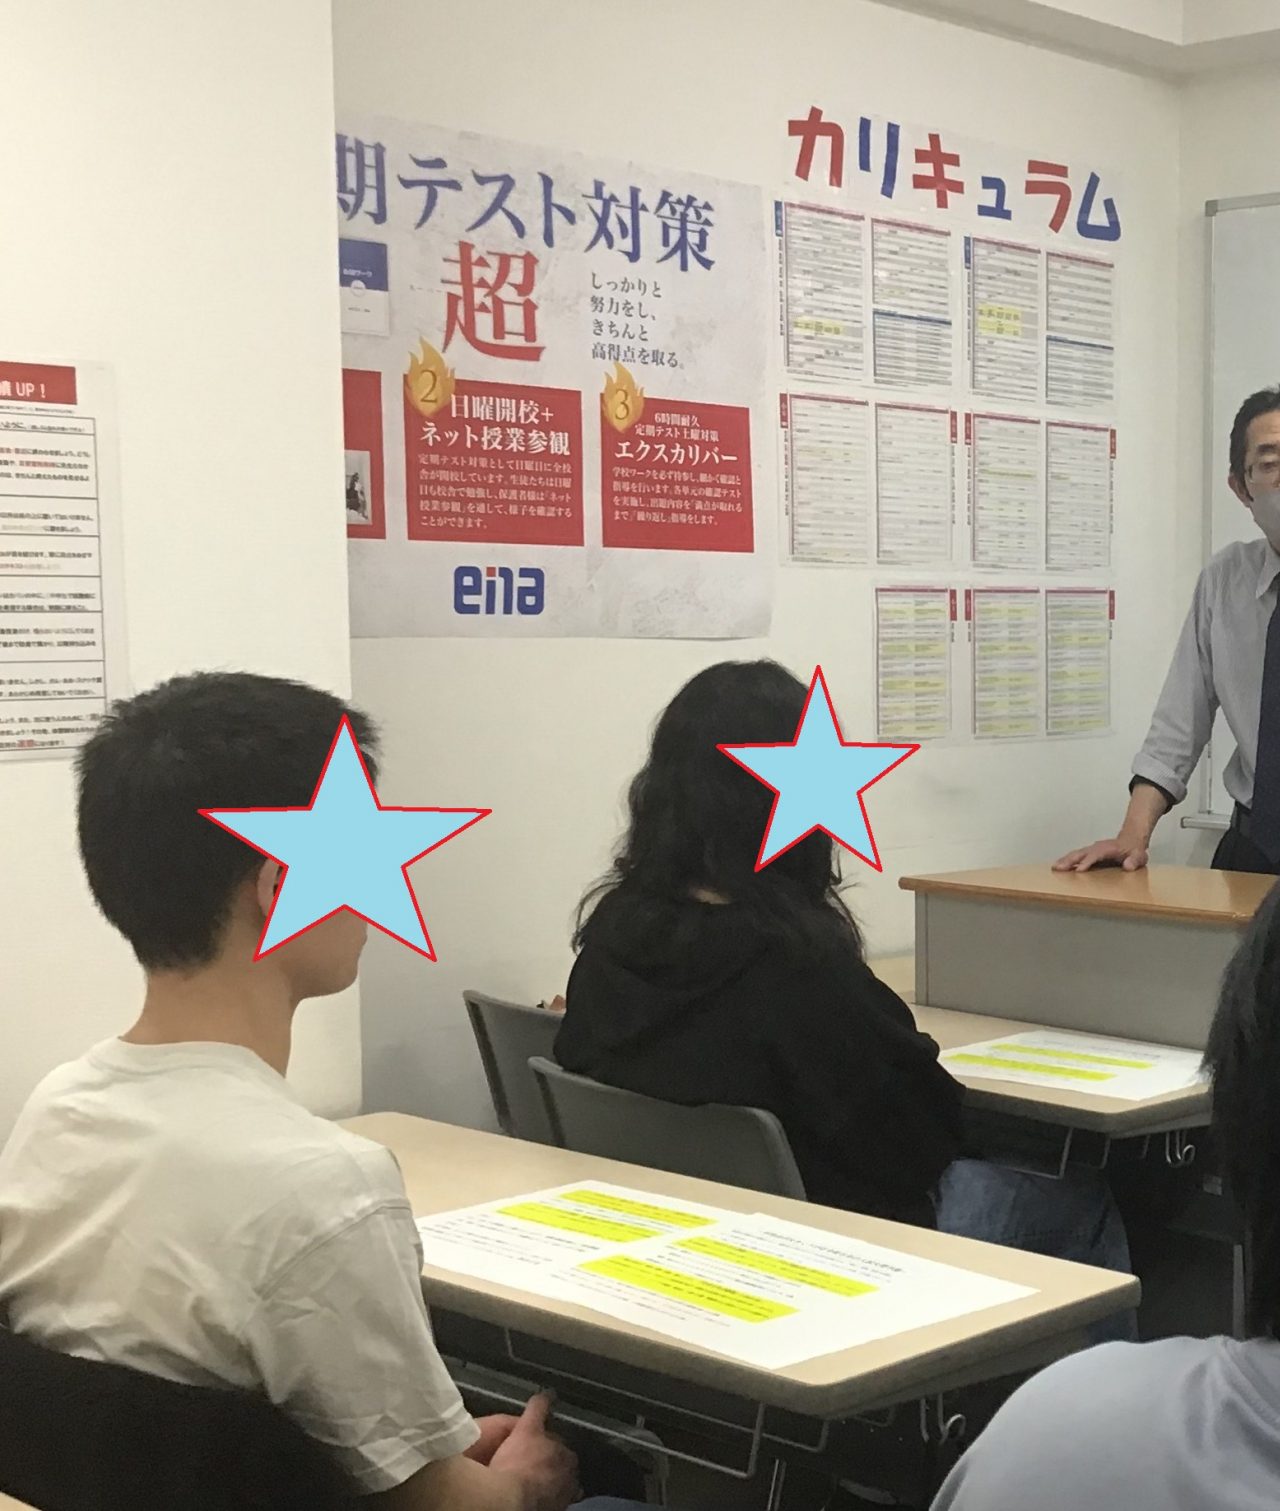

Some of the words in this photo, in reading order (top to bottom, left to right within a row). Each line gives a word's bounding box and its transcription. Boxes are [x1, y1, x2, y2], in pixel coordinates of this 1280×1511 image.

[788, 105, 1121, 242] カリキュラム
[336, 133, 715, 272] 期テスト対策
[591, 271, 662, 298] しっかりと
[441, 240, 545, 362] 超
[590, 295, 656, 321] 努力をし、
[592, 318, 648, 341] きちんと
[592, 341, 684, 370] 高得点を取る。
[420, 369, 438, 403] 2
[615, 389, 629, 420] 3
[420, 421, 571, 456] ネット授業参観
[614, 440, 738, 466] エクスカリバー
[454, 565, 545, 615] ena
